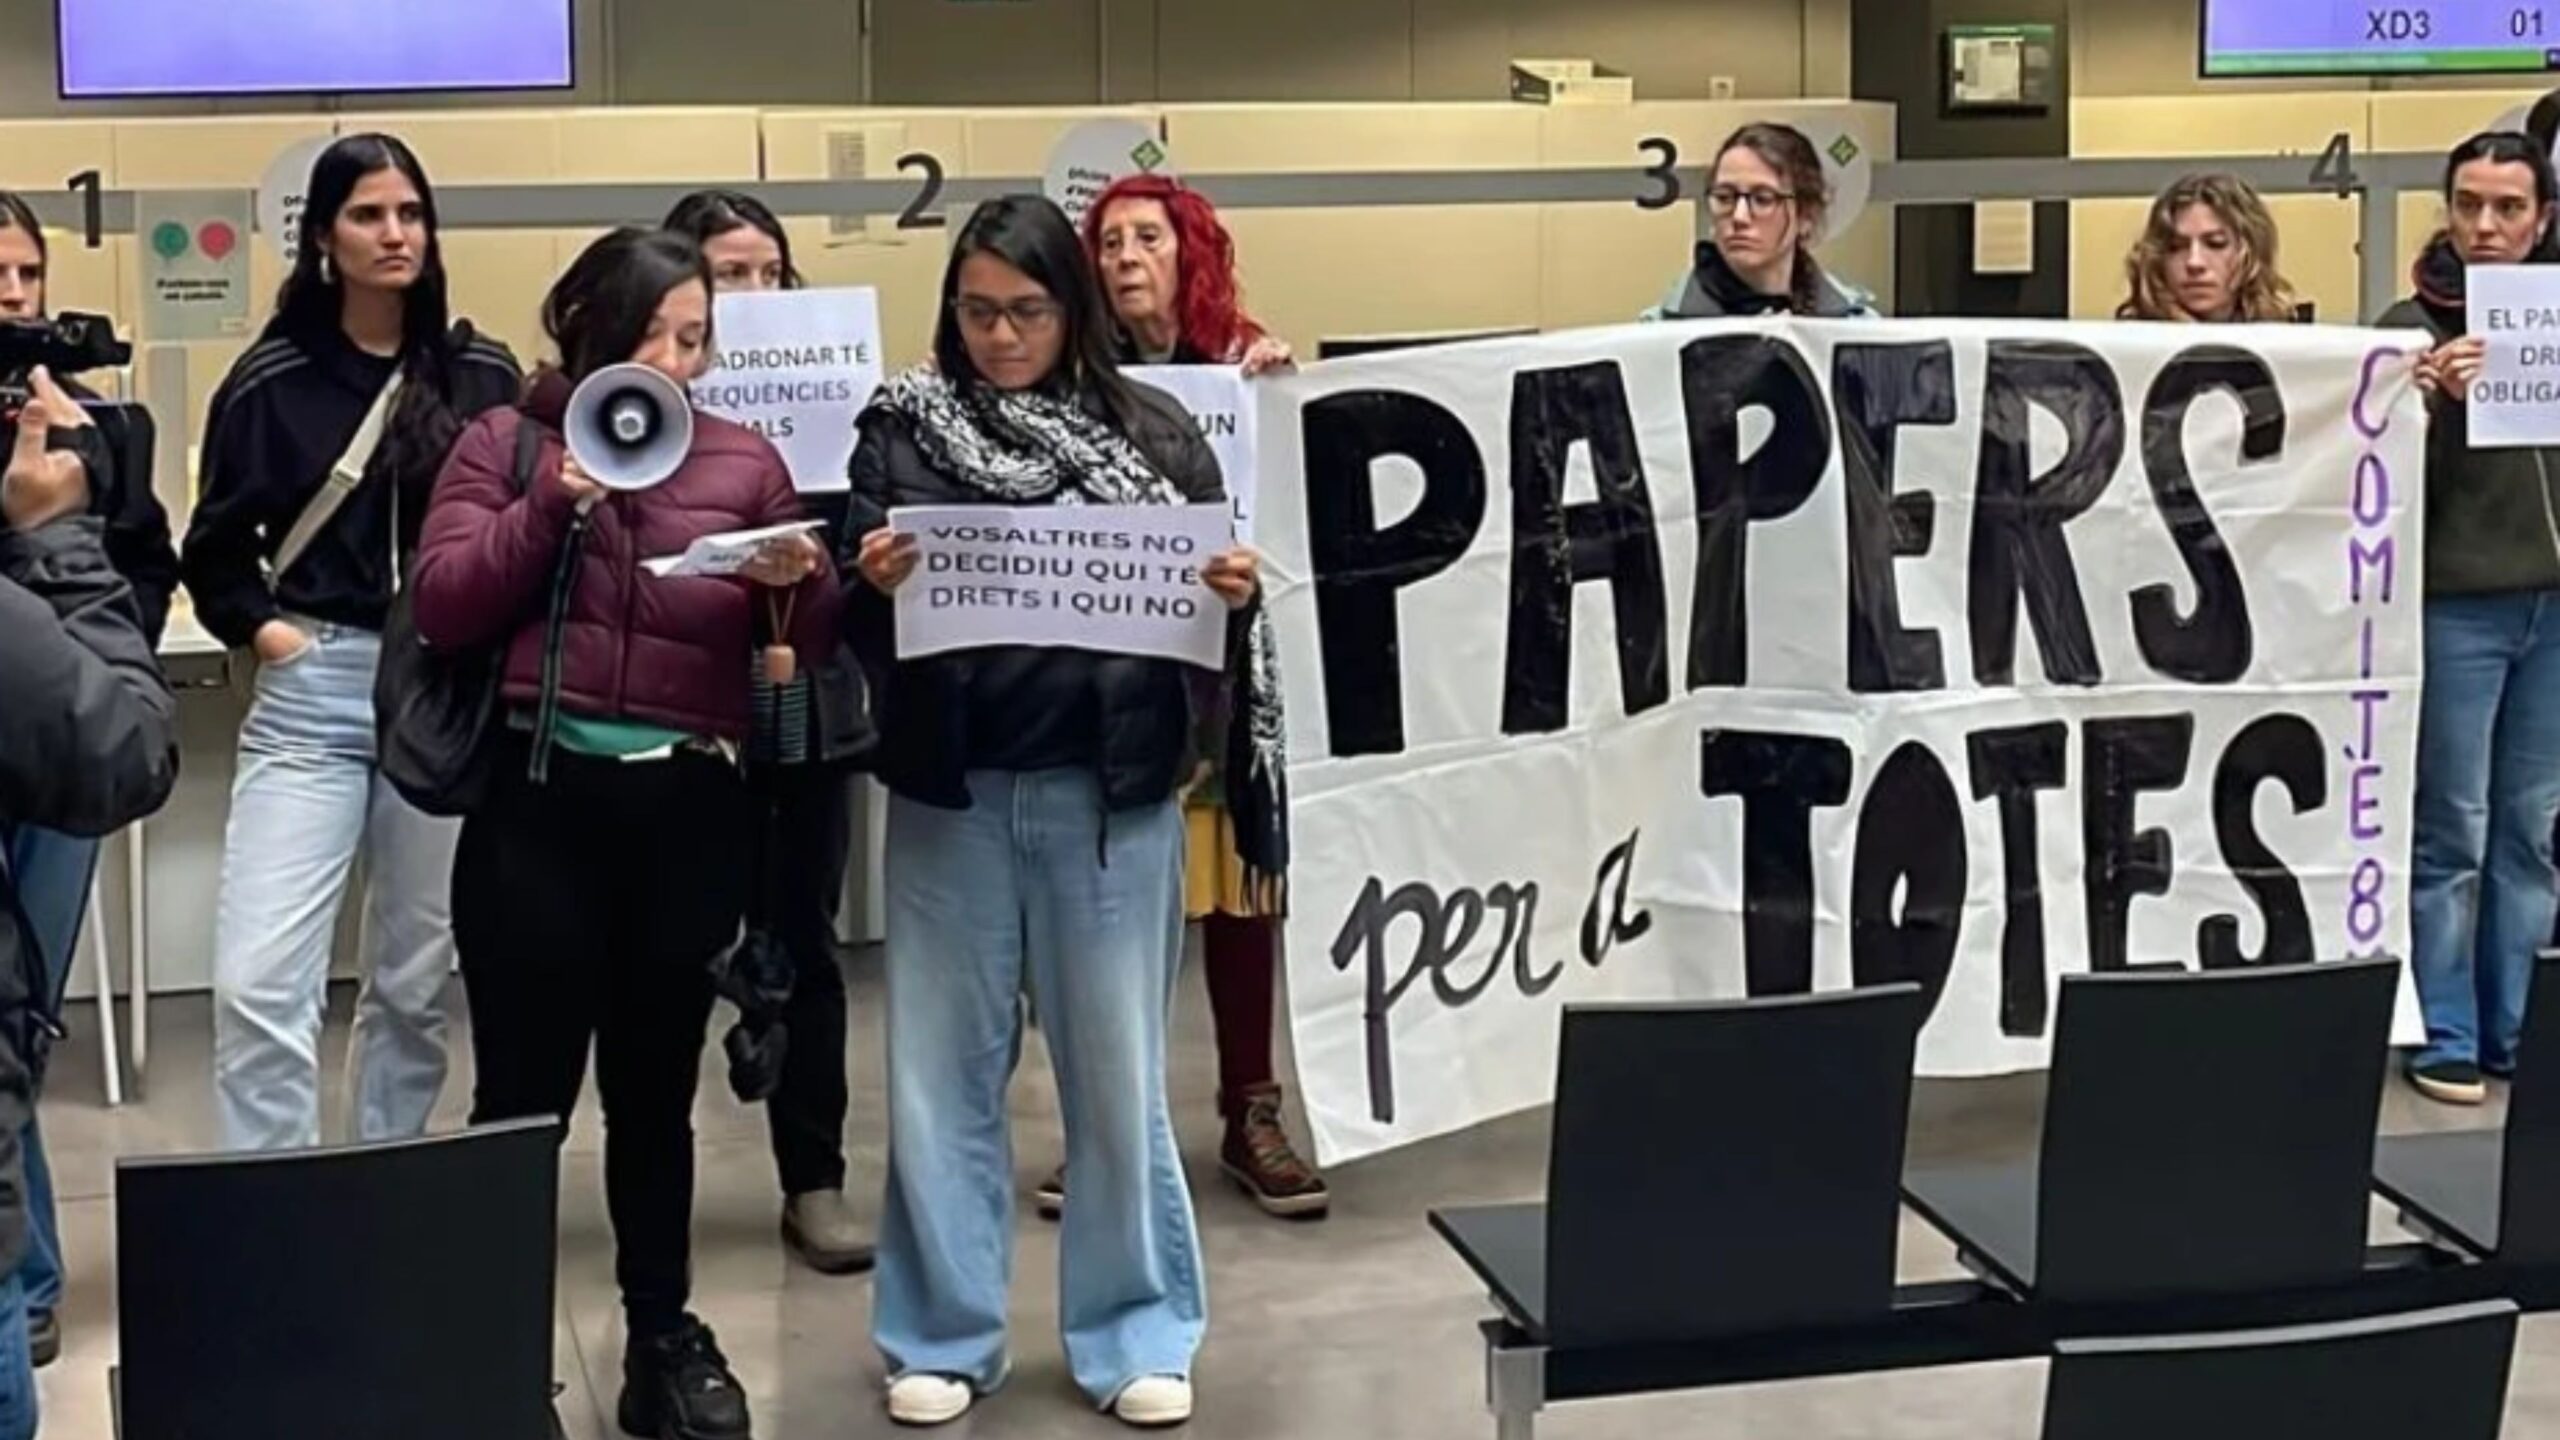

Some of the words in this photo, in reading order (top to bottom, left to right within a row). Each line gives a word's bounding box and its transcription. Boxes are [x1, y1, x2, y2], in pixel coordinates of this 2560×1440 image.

[2366, 9, 2431, 40] XD3
[2510, 9, 2543, 37] 01
[896, 152, 946, 229] 2
[1635, 137, 1681, 209] 3
[2308, 132, 2357, 199] 4
[68, 170, 101, 249] 1
[2488, 308, 2517, 330] EL
[2524, 308, 2560, 329] PA
[929, 552, 1073, 578] DECIDIU
[1085, 559, 1147, 583] QUI
[1158, 565, 1199, 586] TÉ
[930, 526, 1131, 550] VOSALTRES
[1142, 533, 1195, 556] NO
[1302, 332, 2286, 757] PAPERS
[930, 585, 1041, 610] DRETS
[1052, 590, 1059, 609] I
[1071, 592, 1133, 616] QUI
[1143, 597, 1196, 619] NO
[1330, 875, 1564, 1124] per
[1580, 826, 1652, 967] a
[1701, 712, 2326, 1038] TOTES
